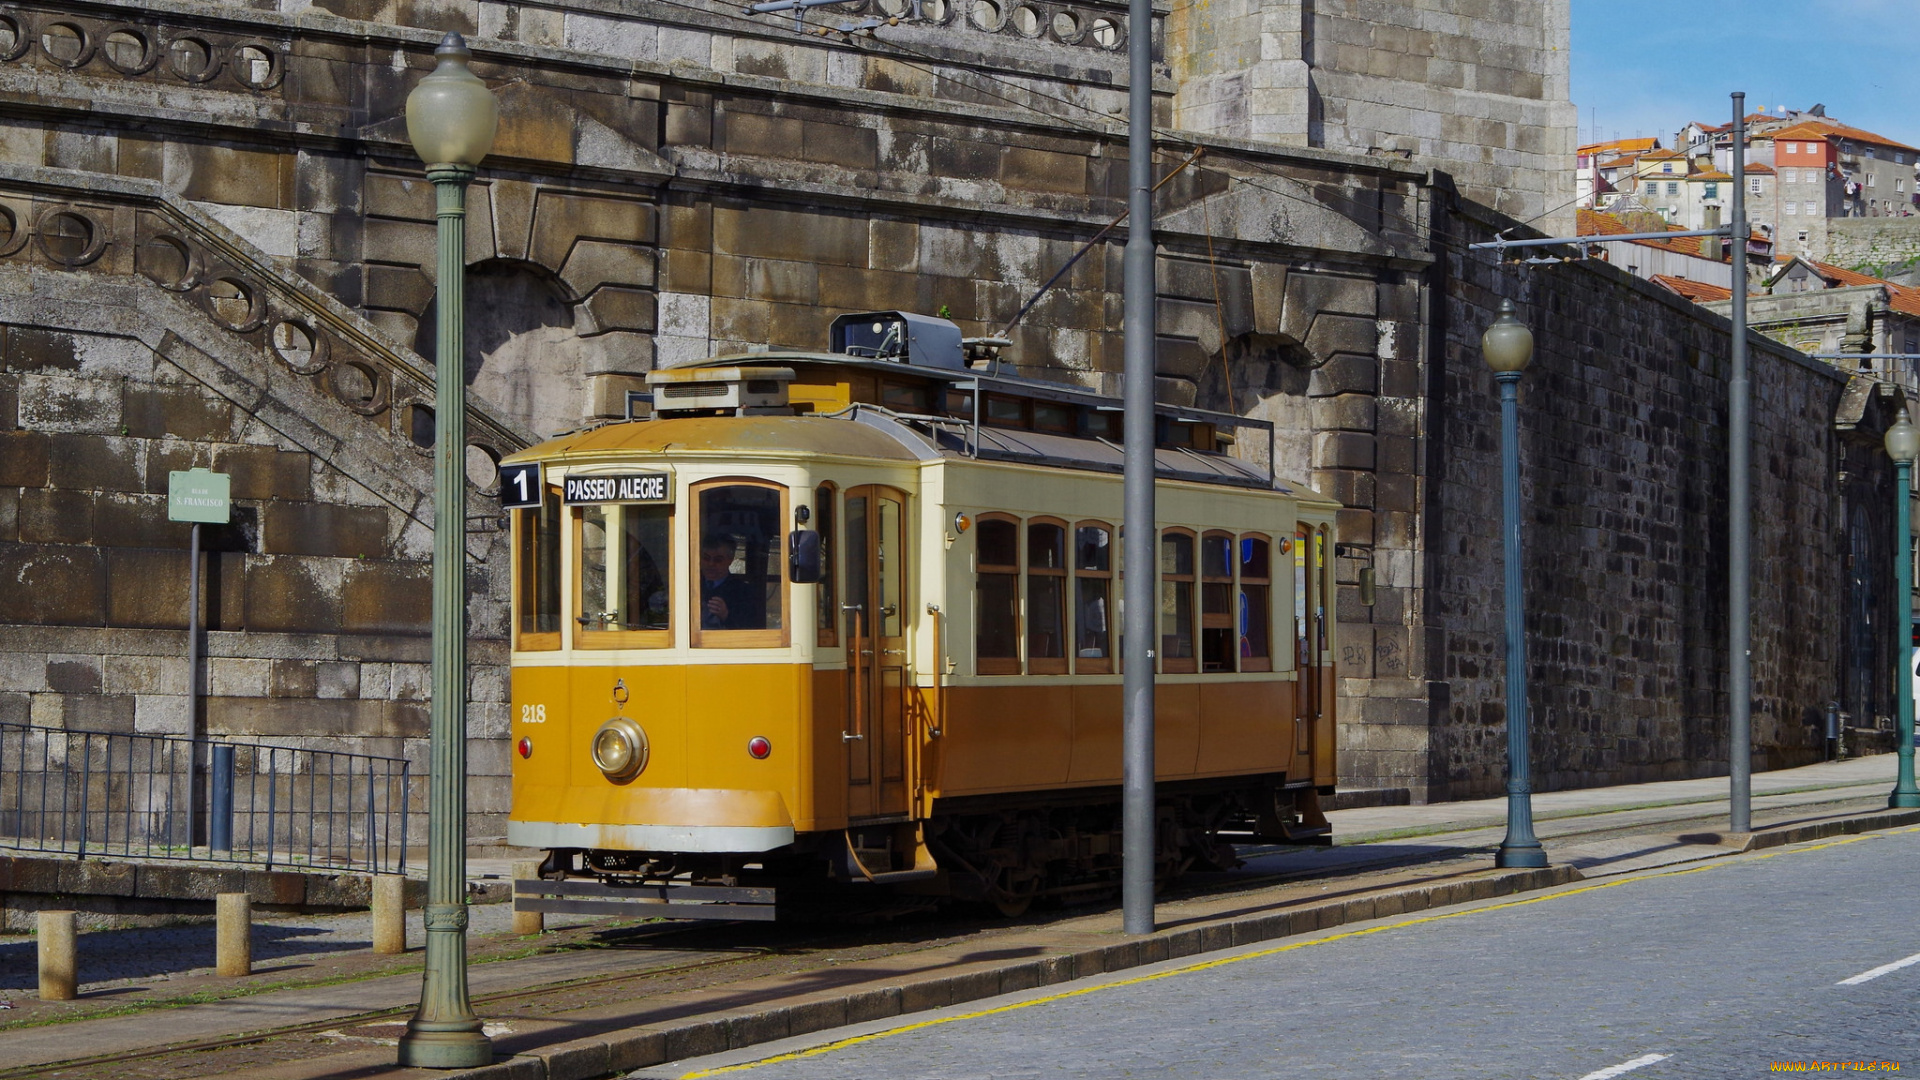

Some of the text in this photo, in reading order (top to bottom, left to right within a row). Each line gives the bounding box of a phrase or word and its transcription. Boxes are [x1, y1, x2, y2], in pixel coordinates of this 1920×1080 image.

[513, 469, 528, 501] 1
[567, 478, 664, 500] PASSEIO ALEGRE
[176, 497, 223, 507] S. FRANCISCO
[522, 704, 546, 723] 218
